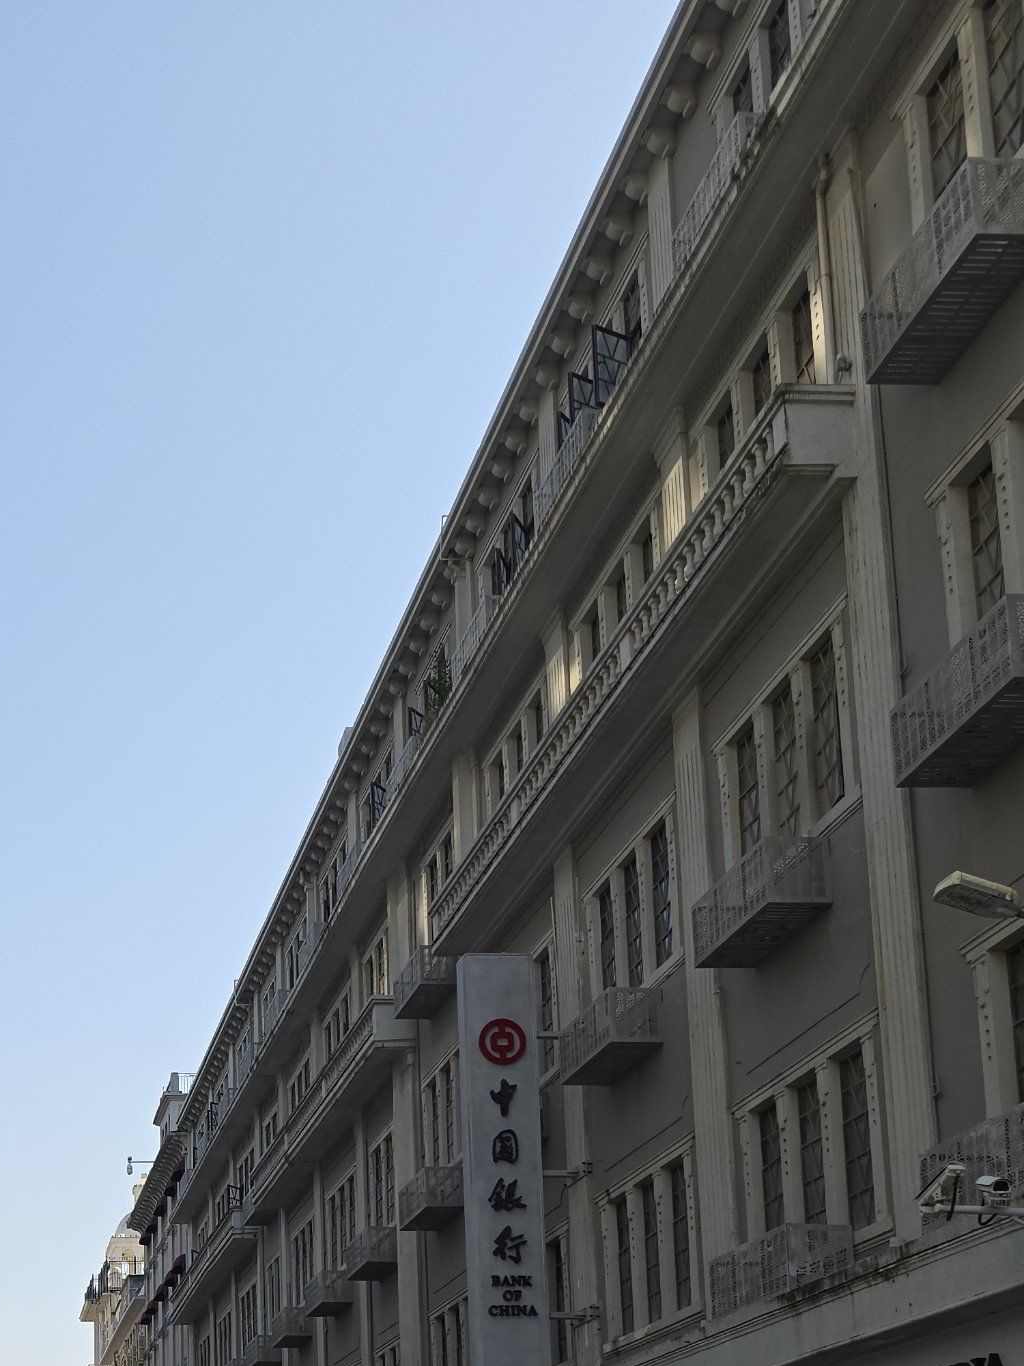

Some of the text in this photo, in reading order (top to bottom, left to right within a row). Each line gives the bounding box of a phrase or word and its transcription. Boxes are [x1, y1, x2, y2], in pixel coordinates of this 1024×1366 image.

[491, 1275, 533, 1287] BANK
[502, 1290, 522, 1302] OF
[487, 1304, 538, 1317] CHINA
